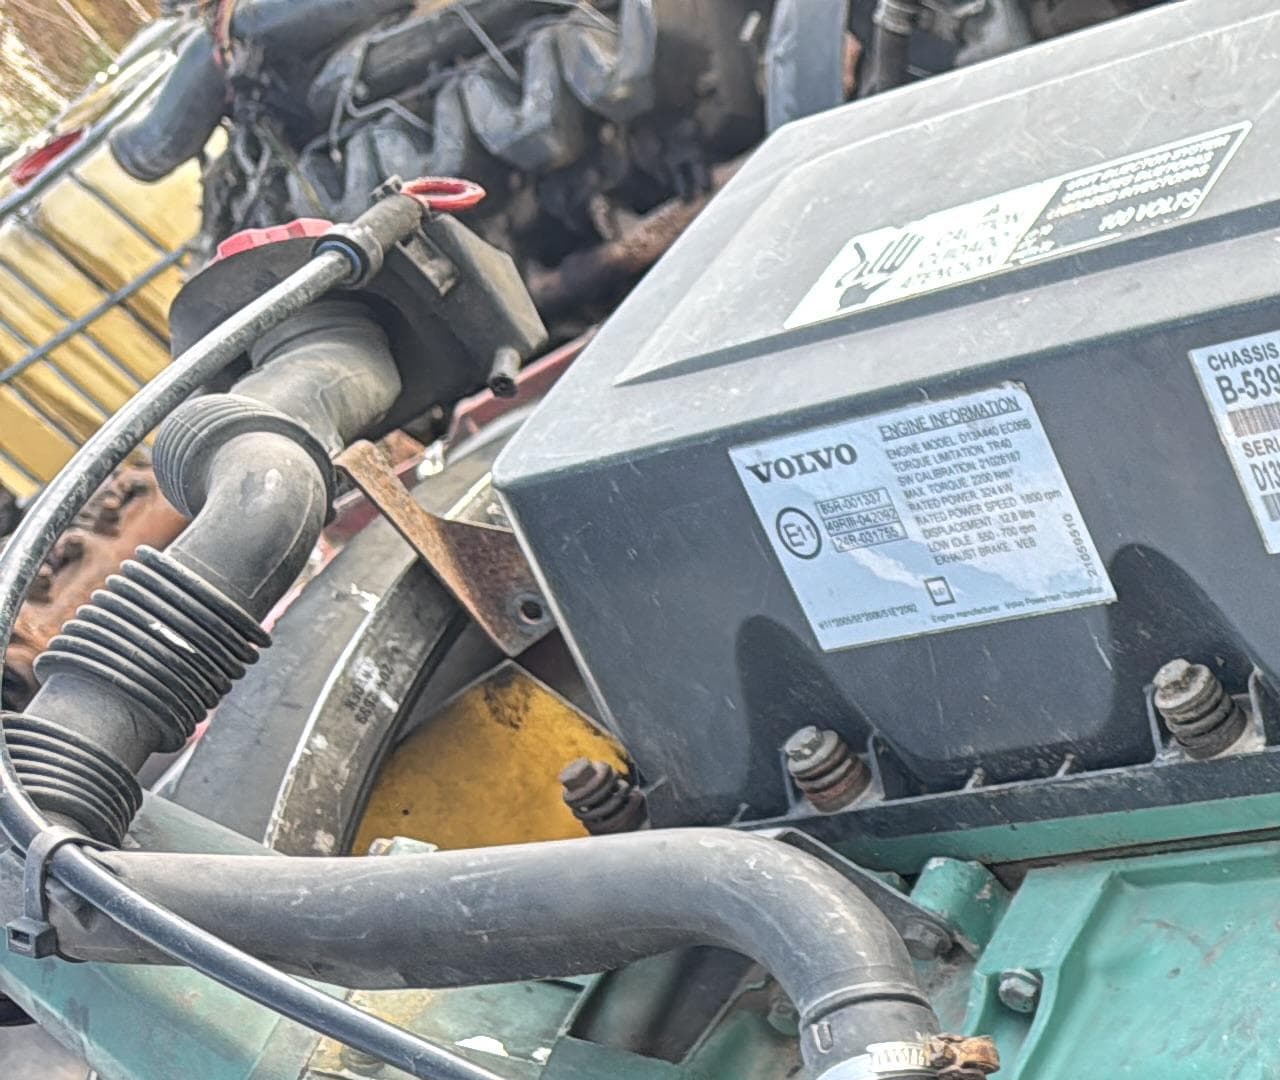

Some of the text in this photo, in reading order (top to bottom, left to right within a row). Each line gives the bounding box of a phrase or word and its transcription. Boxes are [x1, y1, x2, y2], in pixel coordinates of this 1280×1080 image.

[1207, 342, 1280, 371] CHASSIS
[879, 397, 1022, 441] ENGINE INFORMATION
[886, 444, 922, 460] ENGINE
[746, 443, 858, 484] VOLVO
[893, 456, 932, 473] TORQUE
[909, 499, 941, 513] RATED
[948, 505, 984, 520] POWER
[928, 541, 951, 553] LOW
